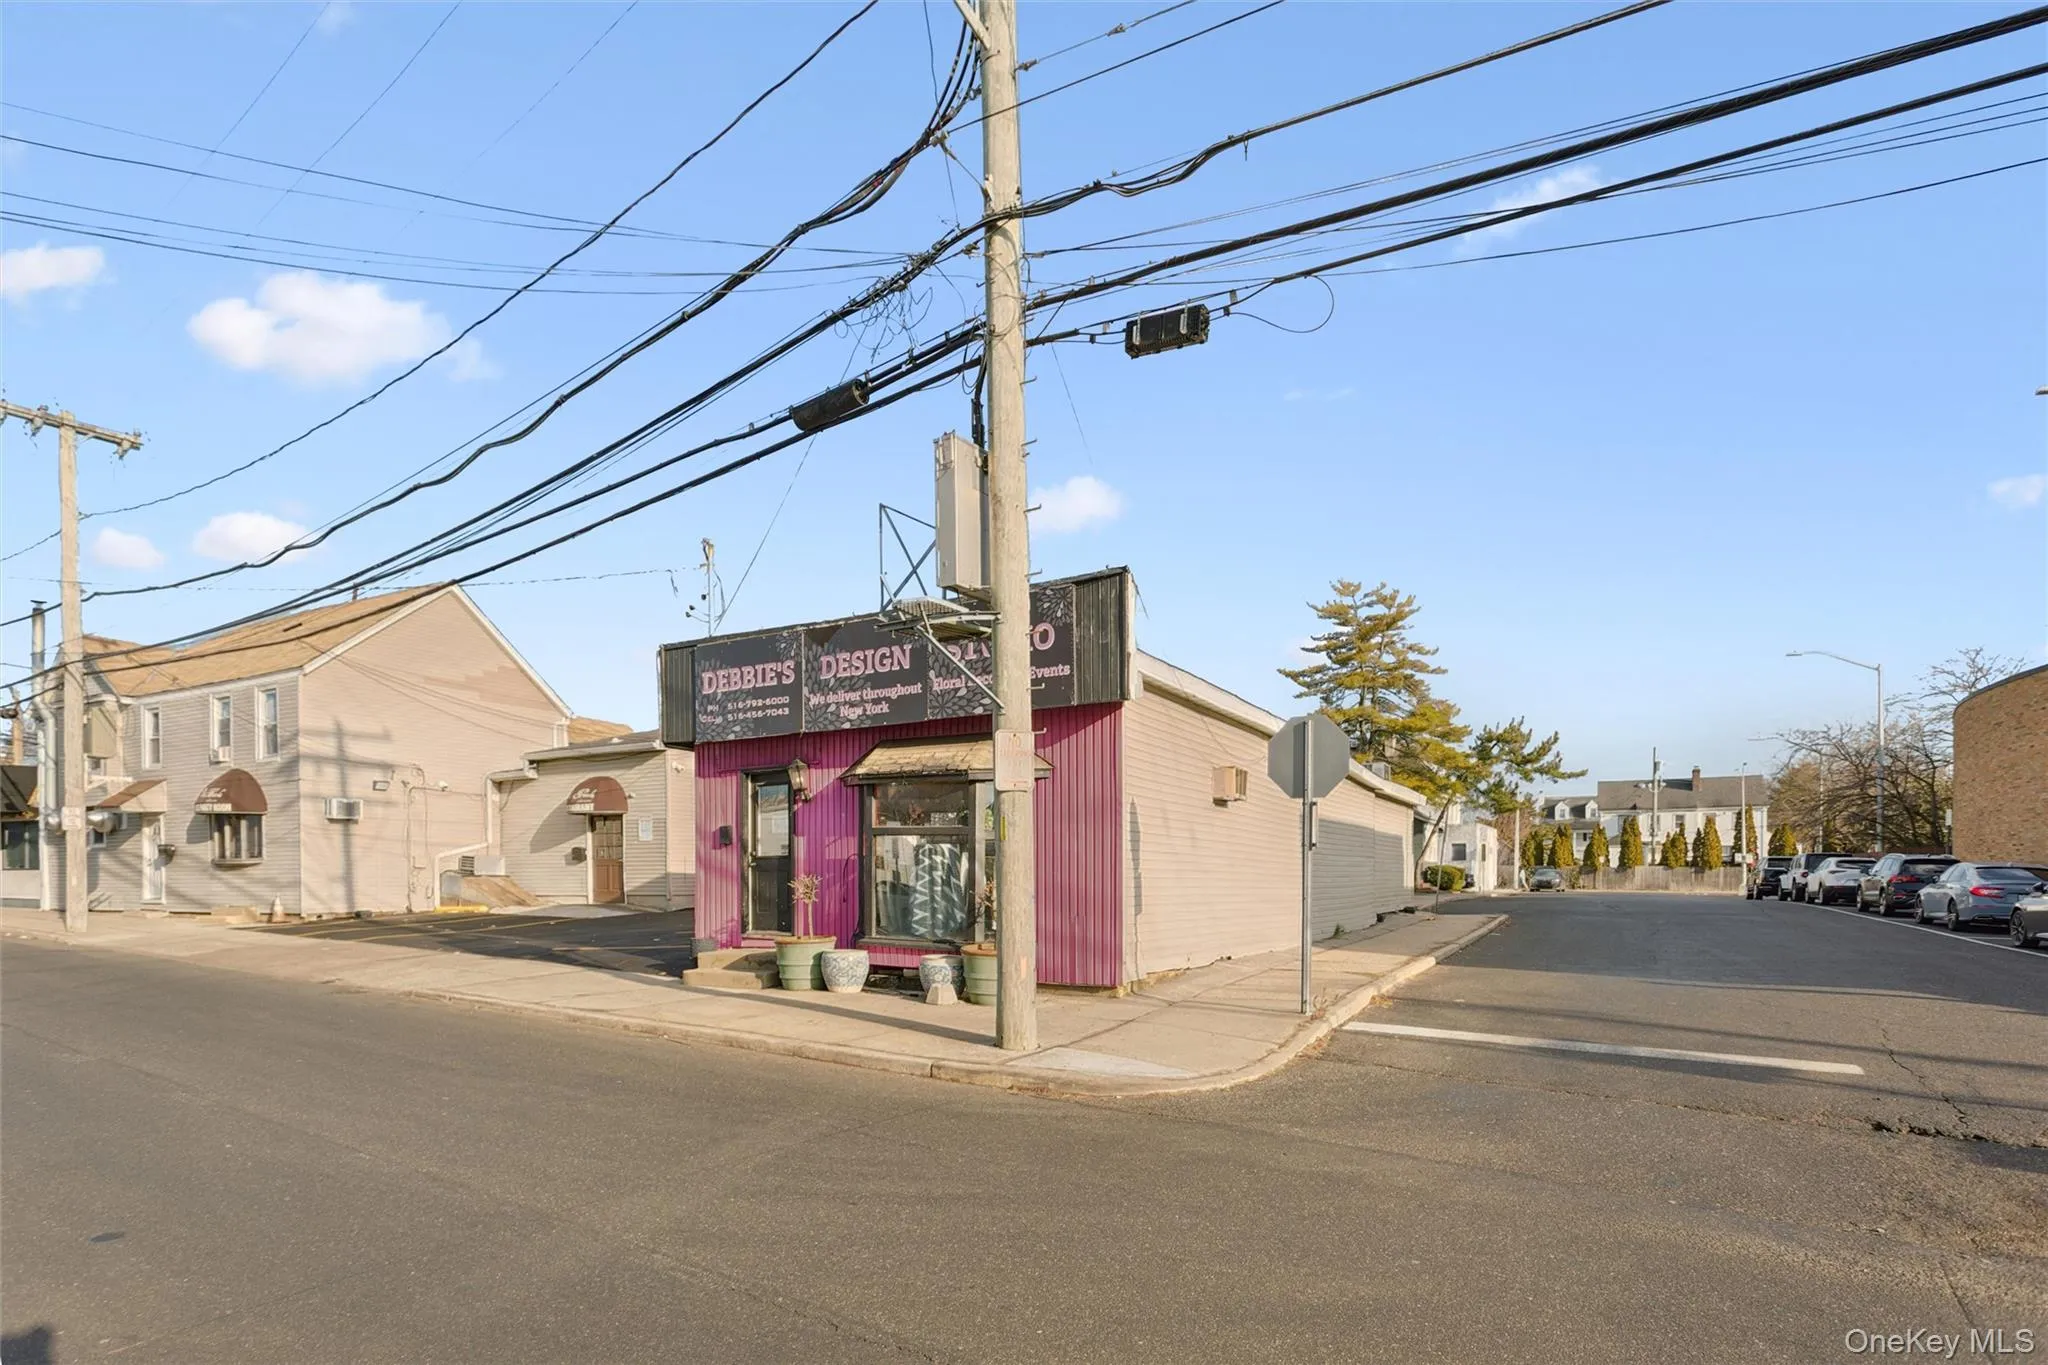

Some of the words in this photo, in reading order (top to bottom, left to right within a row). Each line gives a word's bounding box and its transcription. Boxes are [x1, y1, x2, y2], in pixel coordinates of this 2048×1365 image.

[702, 660, 795, 694] DEBBIE'S
[820, 643, 912, 679] DESIGN
[933, 675, 965, 690] Floral
[809, 693, 825, 705] We
[827, 690, 861, 703] deliver
[863, 682, 922, 699] throughout
[840, 704, 862, 717] New
[864, 701, 890, 715] York
